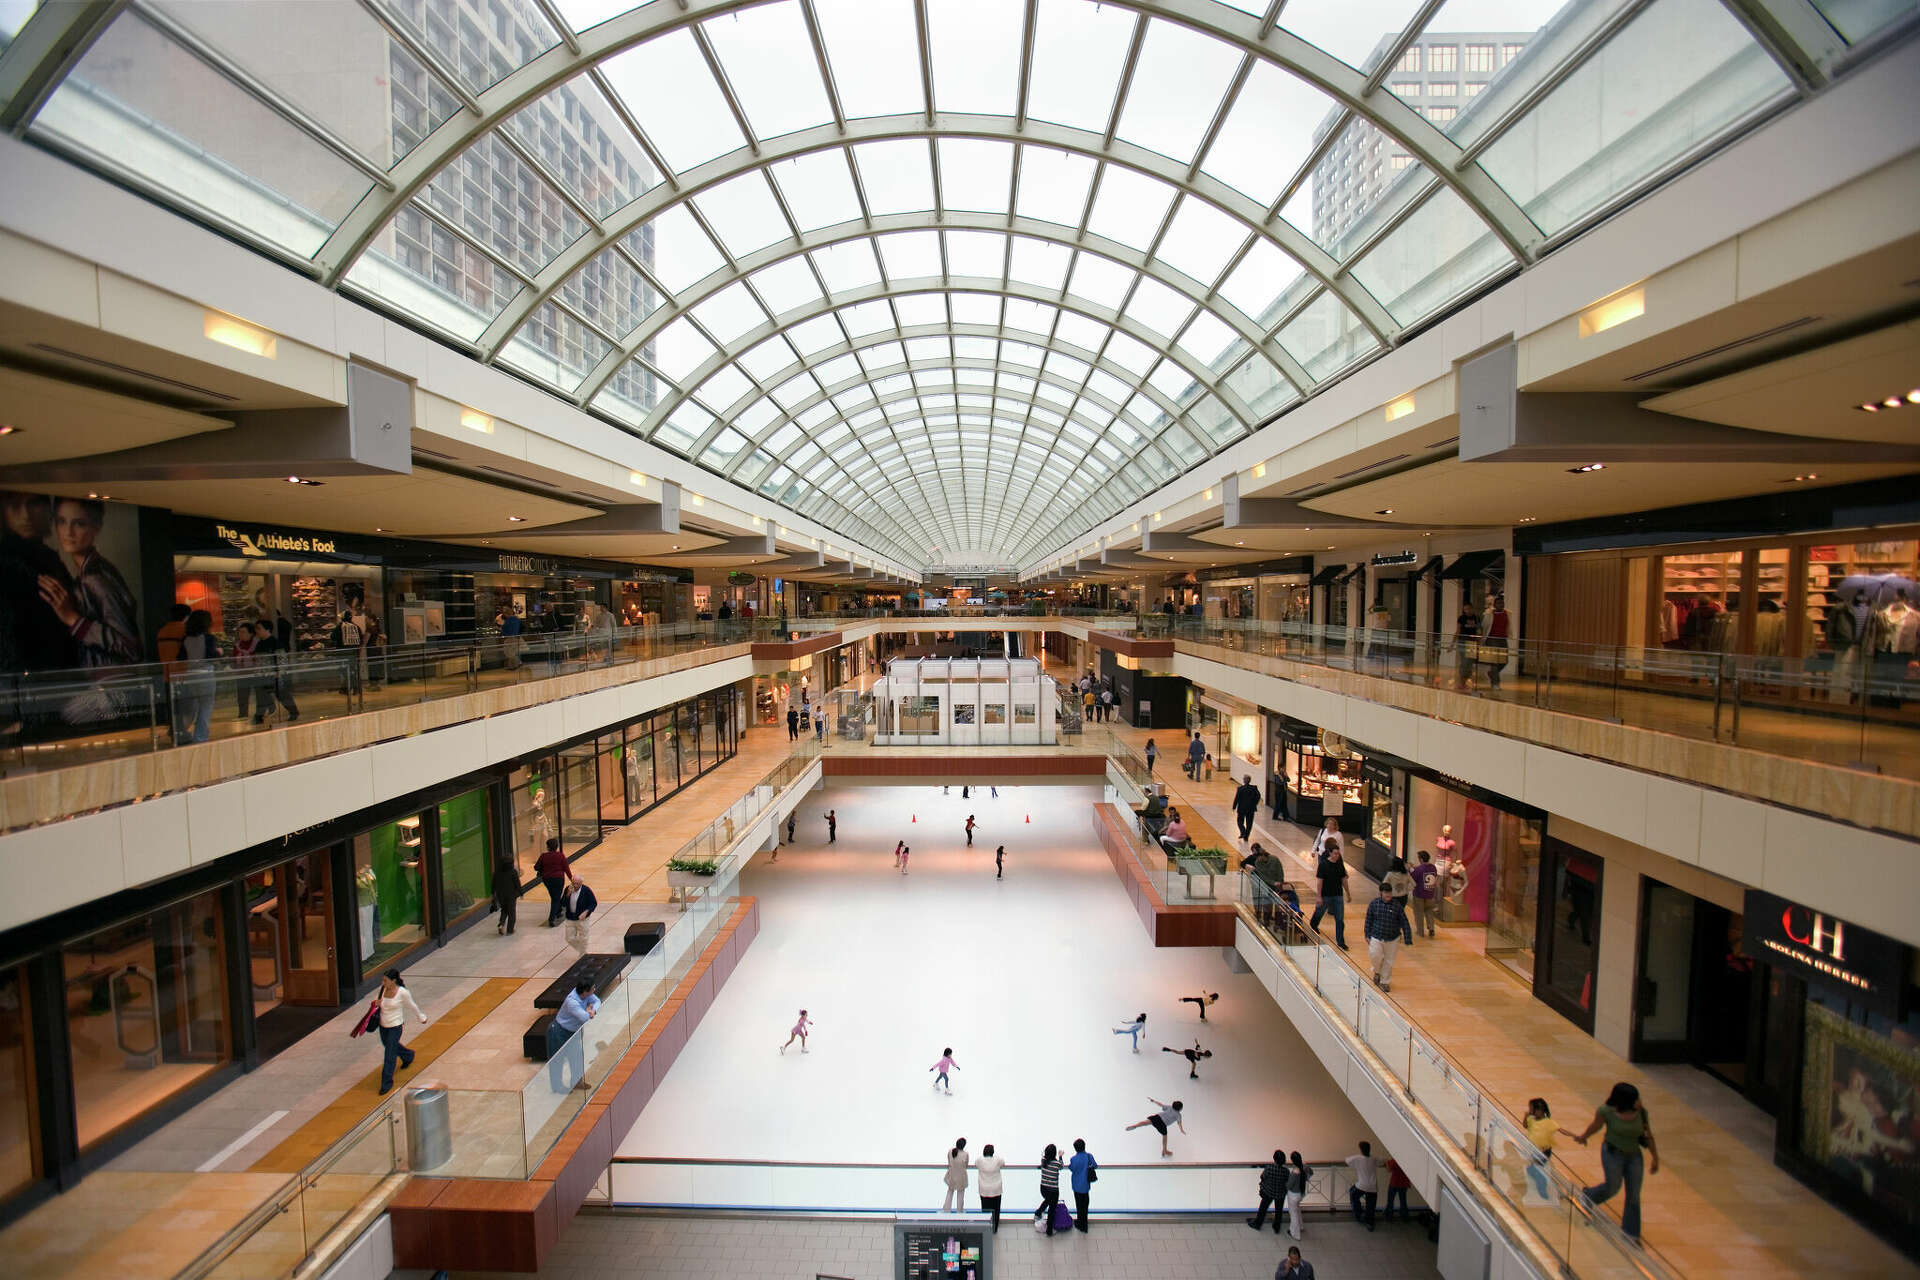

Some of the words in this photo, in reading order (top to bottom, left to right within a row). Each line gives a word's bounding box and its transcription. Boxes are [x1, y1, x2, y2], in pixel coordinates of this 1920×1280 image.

[216, 525, 238, 539] The
[257, 533, 310, 552] Athlete's
[312, 538, 336, 553] Foot
[1782, 904, 1845, 961] CH
[1756, 937, 1813, 966] AROLINA
[1814, 960, 1876, 992] HERRER
